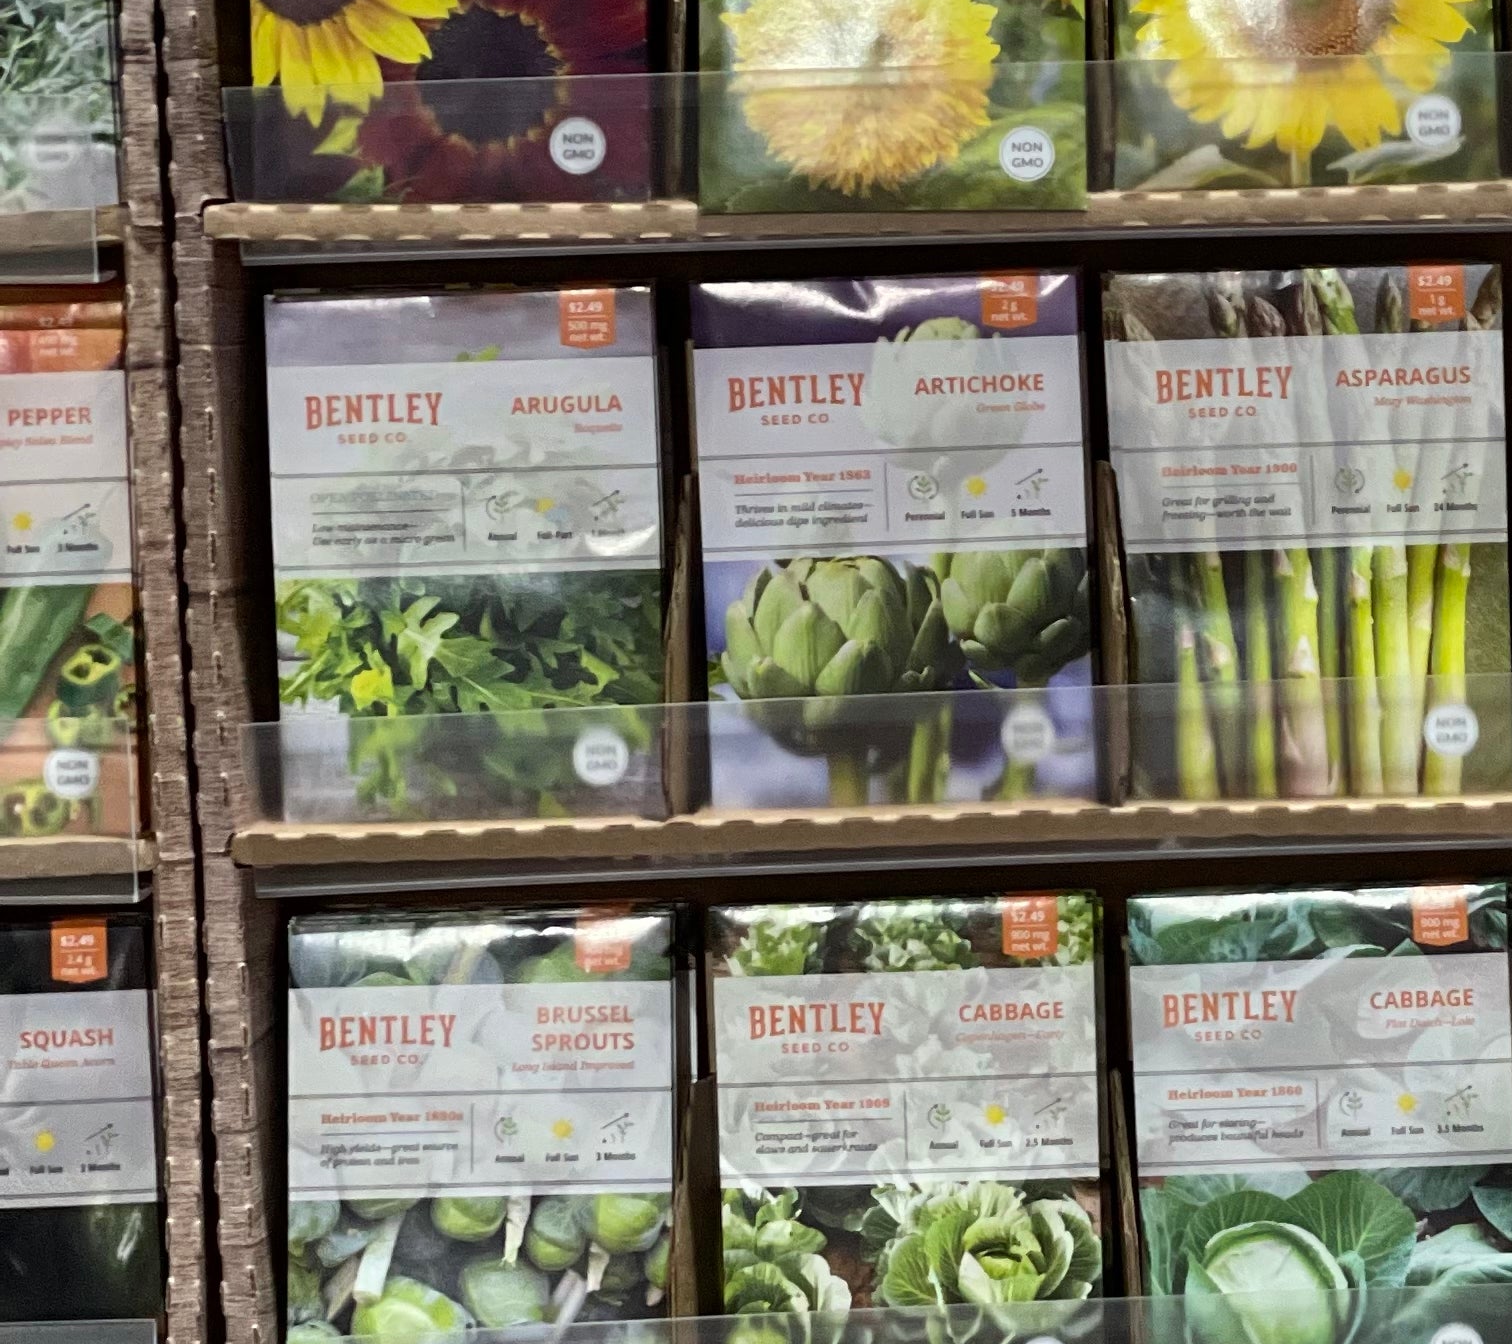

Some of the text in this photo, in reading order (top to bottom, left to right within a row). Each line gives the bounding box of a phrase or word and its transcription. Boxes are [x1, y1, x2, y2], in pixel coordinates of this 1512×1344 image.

[1418, 272, 1452, 286] $2.49
[569, 302, 603, 312] $2.49
[915, 374, 1043, 395] ARTICHOKE
[1156, 366, 1292, 404] BENTLEY
[1335, 366, 1470, 387] ASPARAGUS
[728, 373, 864, 412] BENTLEY
[305, 393, 442, 430] BENTLEY
[512, 395, 622, 414] ARUGULA
[7, 407, 90, 426] PEPPER
[1011, 910, 1045, 923] $2.49
[61, 935, 94, 946] $2.49
[1370, 988, 1473, 1009] CABBAGE
[537, 1005, 634, 1026] BRUSSEL
[959, 1002, 1062, 1022] CABBAGE
[1163, 991, 1296, 1028] BENTLEY
[749, 1003, 884, 1039] BENTLEY
[19, 1028, 113, 1051] SQUASH
[320, 1015, 455, 1051] BENTLEY
[533, 1032, 634, 1051] SPROUTS
[350, 1054, 391, 1065] SEED
